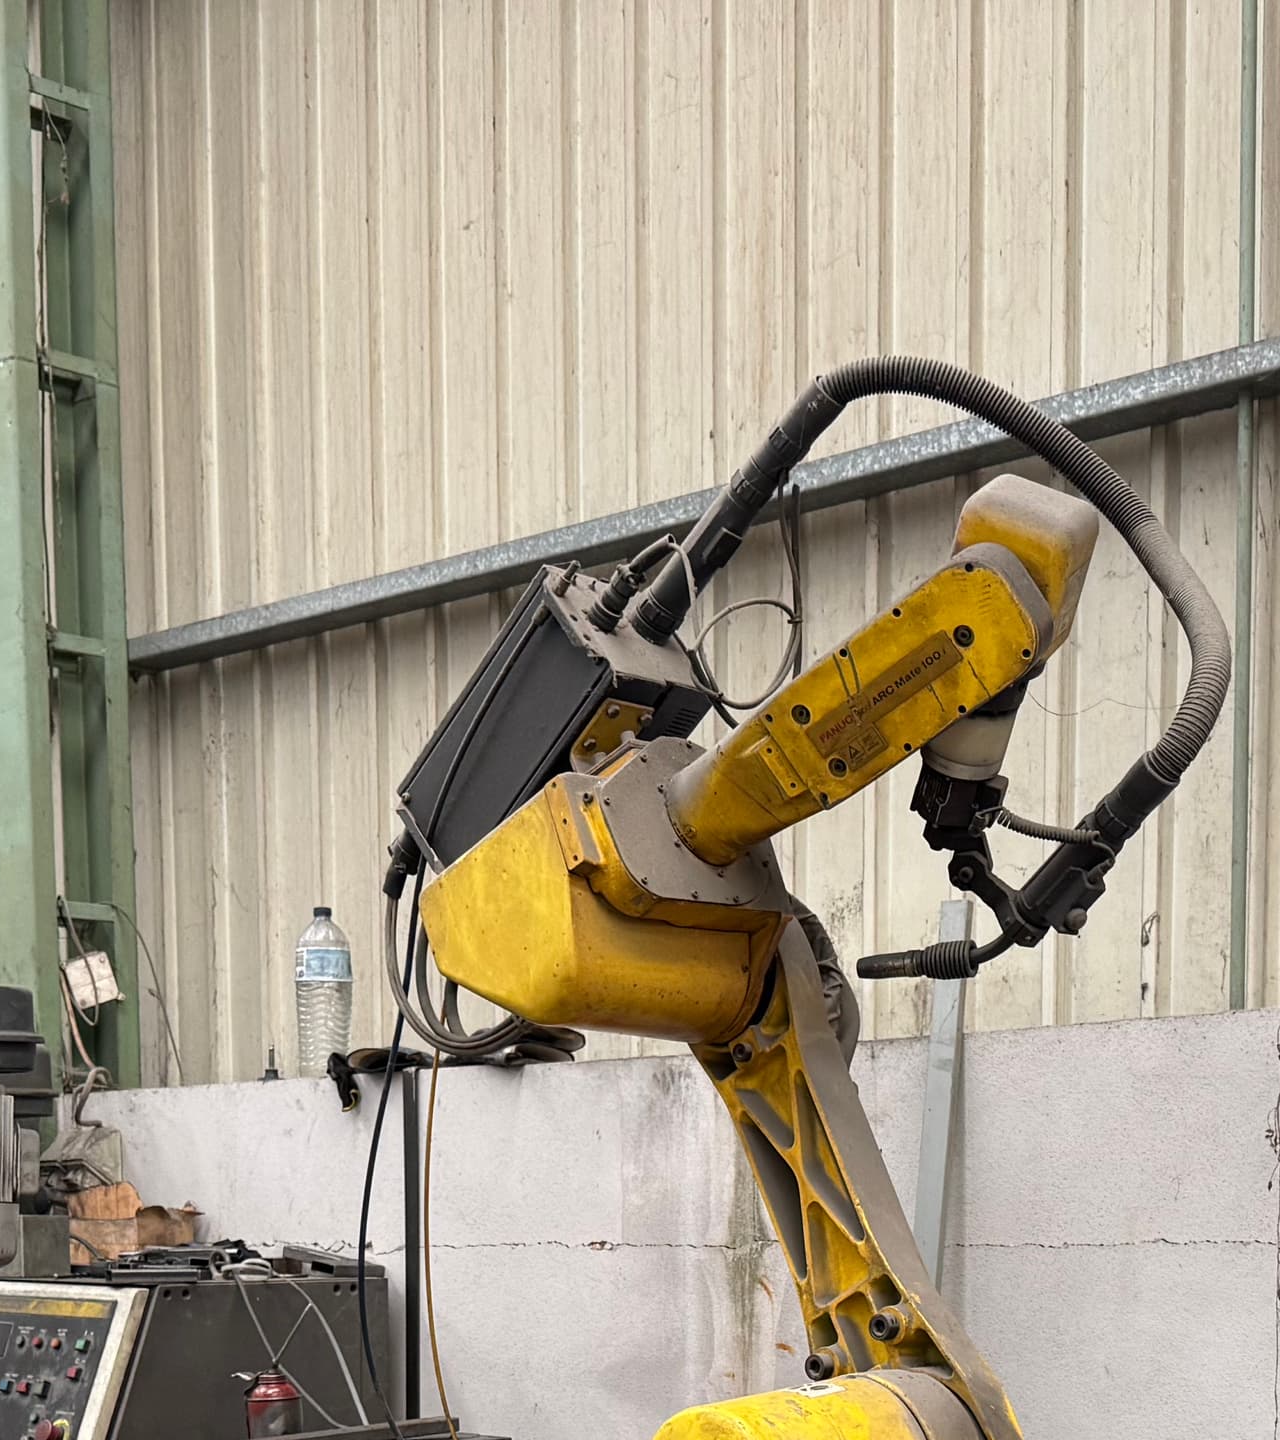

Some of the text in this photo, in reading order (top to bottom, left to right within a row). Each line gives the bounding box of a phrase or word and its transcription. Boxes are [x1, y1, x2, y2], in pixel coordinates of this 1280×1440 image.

[819, 714, 853, 744] FANUC
[871, 685, 895, 706] ARC
[894, 667, 921, 690] Mate
